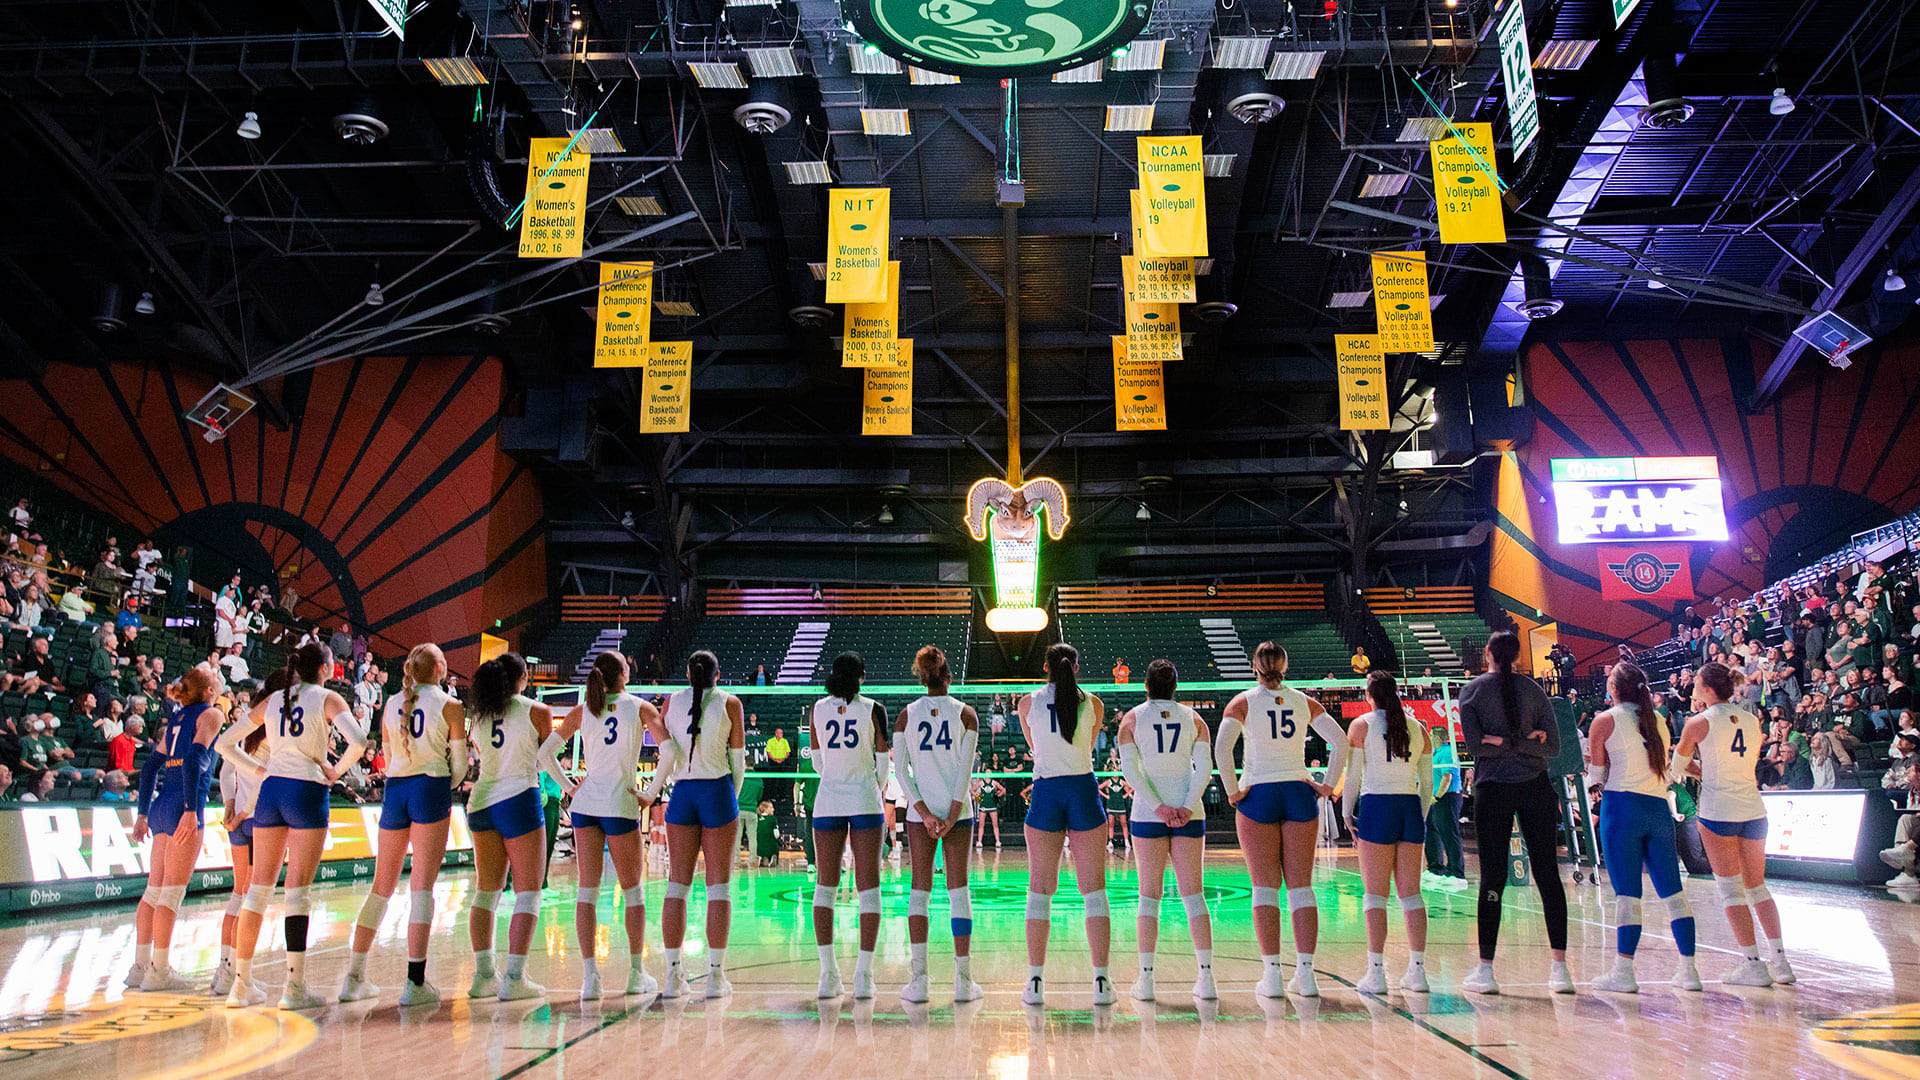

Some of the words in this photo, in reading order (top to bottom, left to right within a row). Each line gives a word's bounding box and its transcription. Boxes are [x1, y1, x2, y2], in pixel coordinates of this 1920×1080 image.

[1500, 12, 1524, 55] SHERRI
[1507, 40, 1526, 93] 12
[1445, 127, 1476, 139] MWC
[1152, 145, 1188, 157] NCAA
[1437, 144, 1487, 155] Conference
[546, 152, 573, 162] NCAA
[533, 166, 585, 177] Tournament
[1141, 161, 1201, 172] Tournament
[1445, 186, 1490, 199] Volleyball
[535, 200, 575, 210] Women's
[1150, 198, 1195, 212] Volleyball
[1445, 202, 1458, 213] 19,
[1461, 202, 1472, 212] 21
[529, 216, 575, 227] Basketball
[1149, 215, 1160, 225] 19
[530, 230, 549, 240] 1996,
[551, 230, 563, 240] 98,
[566, 230, 575, 239] 99
[520, 244, 533, 254] 01,
[536, 243, 548, 253] 02,
[552, 243, 562, 253] 16
[838, 245, 878, 256] Women's
[835, 258, 880, 268] Basketball
[1139, 260, 1188, 273] Volleyball
[1385, 262, 1412, 272] MWC
[613, 269, 640, 280] MWC
[830, 272, 842, 281] 22
[1172, 274, 1181, 282] 07,
[1376, 276, 1425, 286] Conference
[604, 282, 647, 292] Conference
[1378, 289, 1425, 301] Champions
[603, 296, 647, 307] Champions
[854, 317, 890, 327] Women's
[1385, 311, 1423, 323] Volleyball
[605, 322, 640, 332] Women's
[1131, 322, 1176, 333] Volleyball
[850, 328, 892, 339] Basketball
[602, 336, 643, 346] Basketball
[846, 342, 868, 351] 2000,
[871, 342, 884, 351] 03,
[1348, 340, 1370, 349] HCAC
[640, 347, 647, 356] 17
[660, 346, 676, 354] WAC
[648, 358, 687, 367] Conference
[875, 353, 884, 363] 17,
[1339, 353, 1382, 362] Conference
[648, 369, 686, 380] Champions
[867, 369, 910, 378] Tournament
[1117, 367, 1160, 376] Tournament
[1340, 365, 1382, 378] Champions
[867, 381, 908, 392] Champions
[1119, 378, 1160, 389] Champions
[651, 394, 680, 402] Women's
[1346, 393, 1380, 403] Volleyball
[649, 405, 682, 415] Basketball
[1123, 404, 1158, 415] Volleyball
[652, 416, 676, 425] 1995-96
[865, 416, 876, 425] 01,
[879, 416, 887, 424] 16
[1350, 410, 1369, 421] 1984,
[1371, 410, 1380, 419] 85
[1639, 567, 1652, 579] 14
[813, 589, 823, 600] A
[1207, 584, 1216, 597] S
[1405, 588, 1415, 600] S
[619, 596, 629, 607] A
[398, 708, 424, 738] 0
[1267, 709, 1296, 739] 15
[491, 719, 505, 748] 5
[604, 716, 618, 745] 3
[825, 719, 859, 749] 25
[918, 720, 952, 751] 24
[170, 725, 181, 757] 7
[1153, 723, 1181, 753] 17
[1731, 729, 1746, 757] 4
